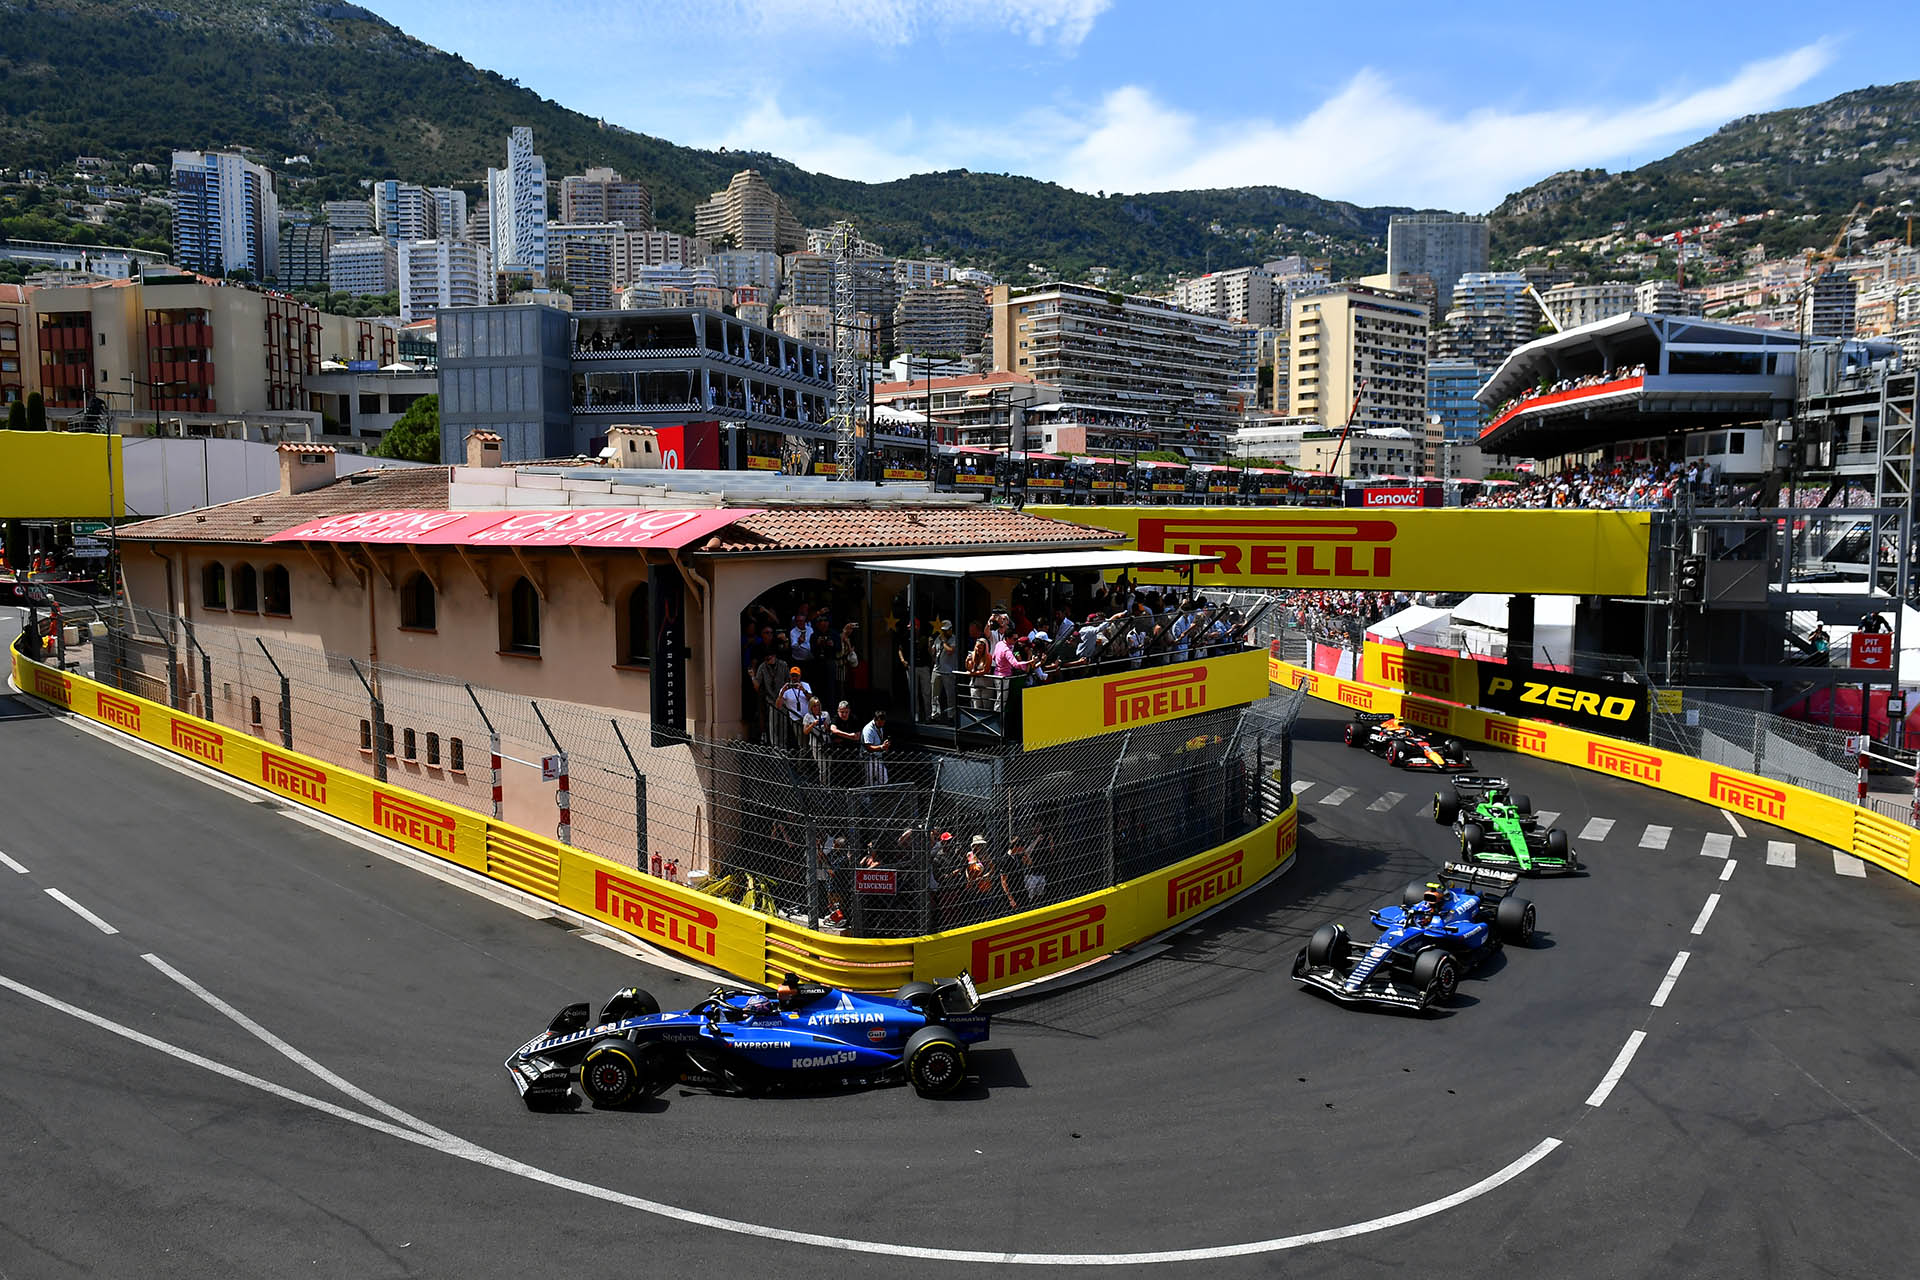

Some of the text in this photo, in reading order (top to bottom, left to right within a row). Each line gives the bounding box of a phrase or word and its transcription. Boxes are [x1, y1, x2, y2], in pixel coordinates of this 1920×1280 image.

[322, 512, 469, 530] CASINO
[501, 512, 697, 530] CASINO
[1138, 519, 1397, 577] PIRELLI
[1860, 646, 1883, 654] LANE
[35, 670, 71, 704] PIRELLI
[1381, 652, 1449, 698] PIRELLI
[97, 690, 140, 732] PIRELLI
[1104, 666, 1208, 727] PIRELLI
[1338, 684, 1373, 709] PIRELLI
[1401, 699, 1449, 728] PIRELLI
[1488, 677, 1513, 695] P
[1519, 681, 1636, 721] ZERO
[171, 718, 224, 764] PIRELLI
[1485, 718, 1547, 752] PIRELLI
[261, 751, 327, 804] PIRELLI
[1588, 741, 1663, 782] PIRELLI
[1709, 771, 1787, 820] PIRELLI
[373, 790, 456, 853] PIRELLI
[1168, 849, 1244, 919] PIRELLI
[595, 869, 718, 957] PIRELLI
[971, 903, 1107, 985] PIRELLI
[808, 1012, 884, 1026] ATLASSIAN
[867, 1031, 887, 1039] Gulf
[662, 1032, 699, 1044] Stephens
[734, 1041, 791, 1049] MYPROTEIN
[543, 1072, 568, 1080] betway
[792, 1051, 857, 1069] KOMATSU
